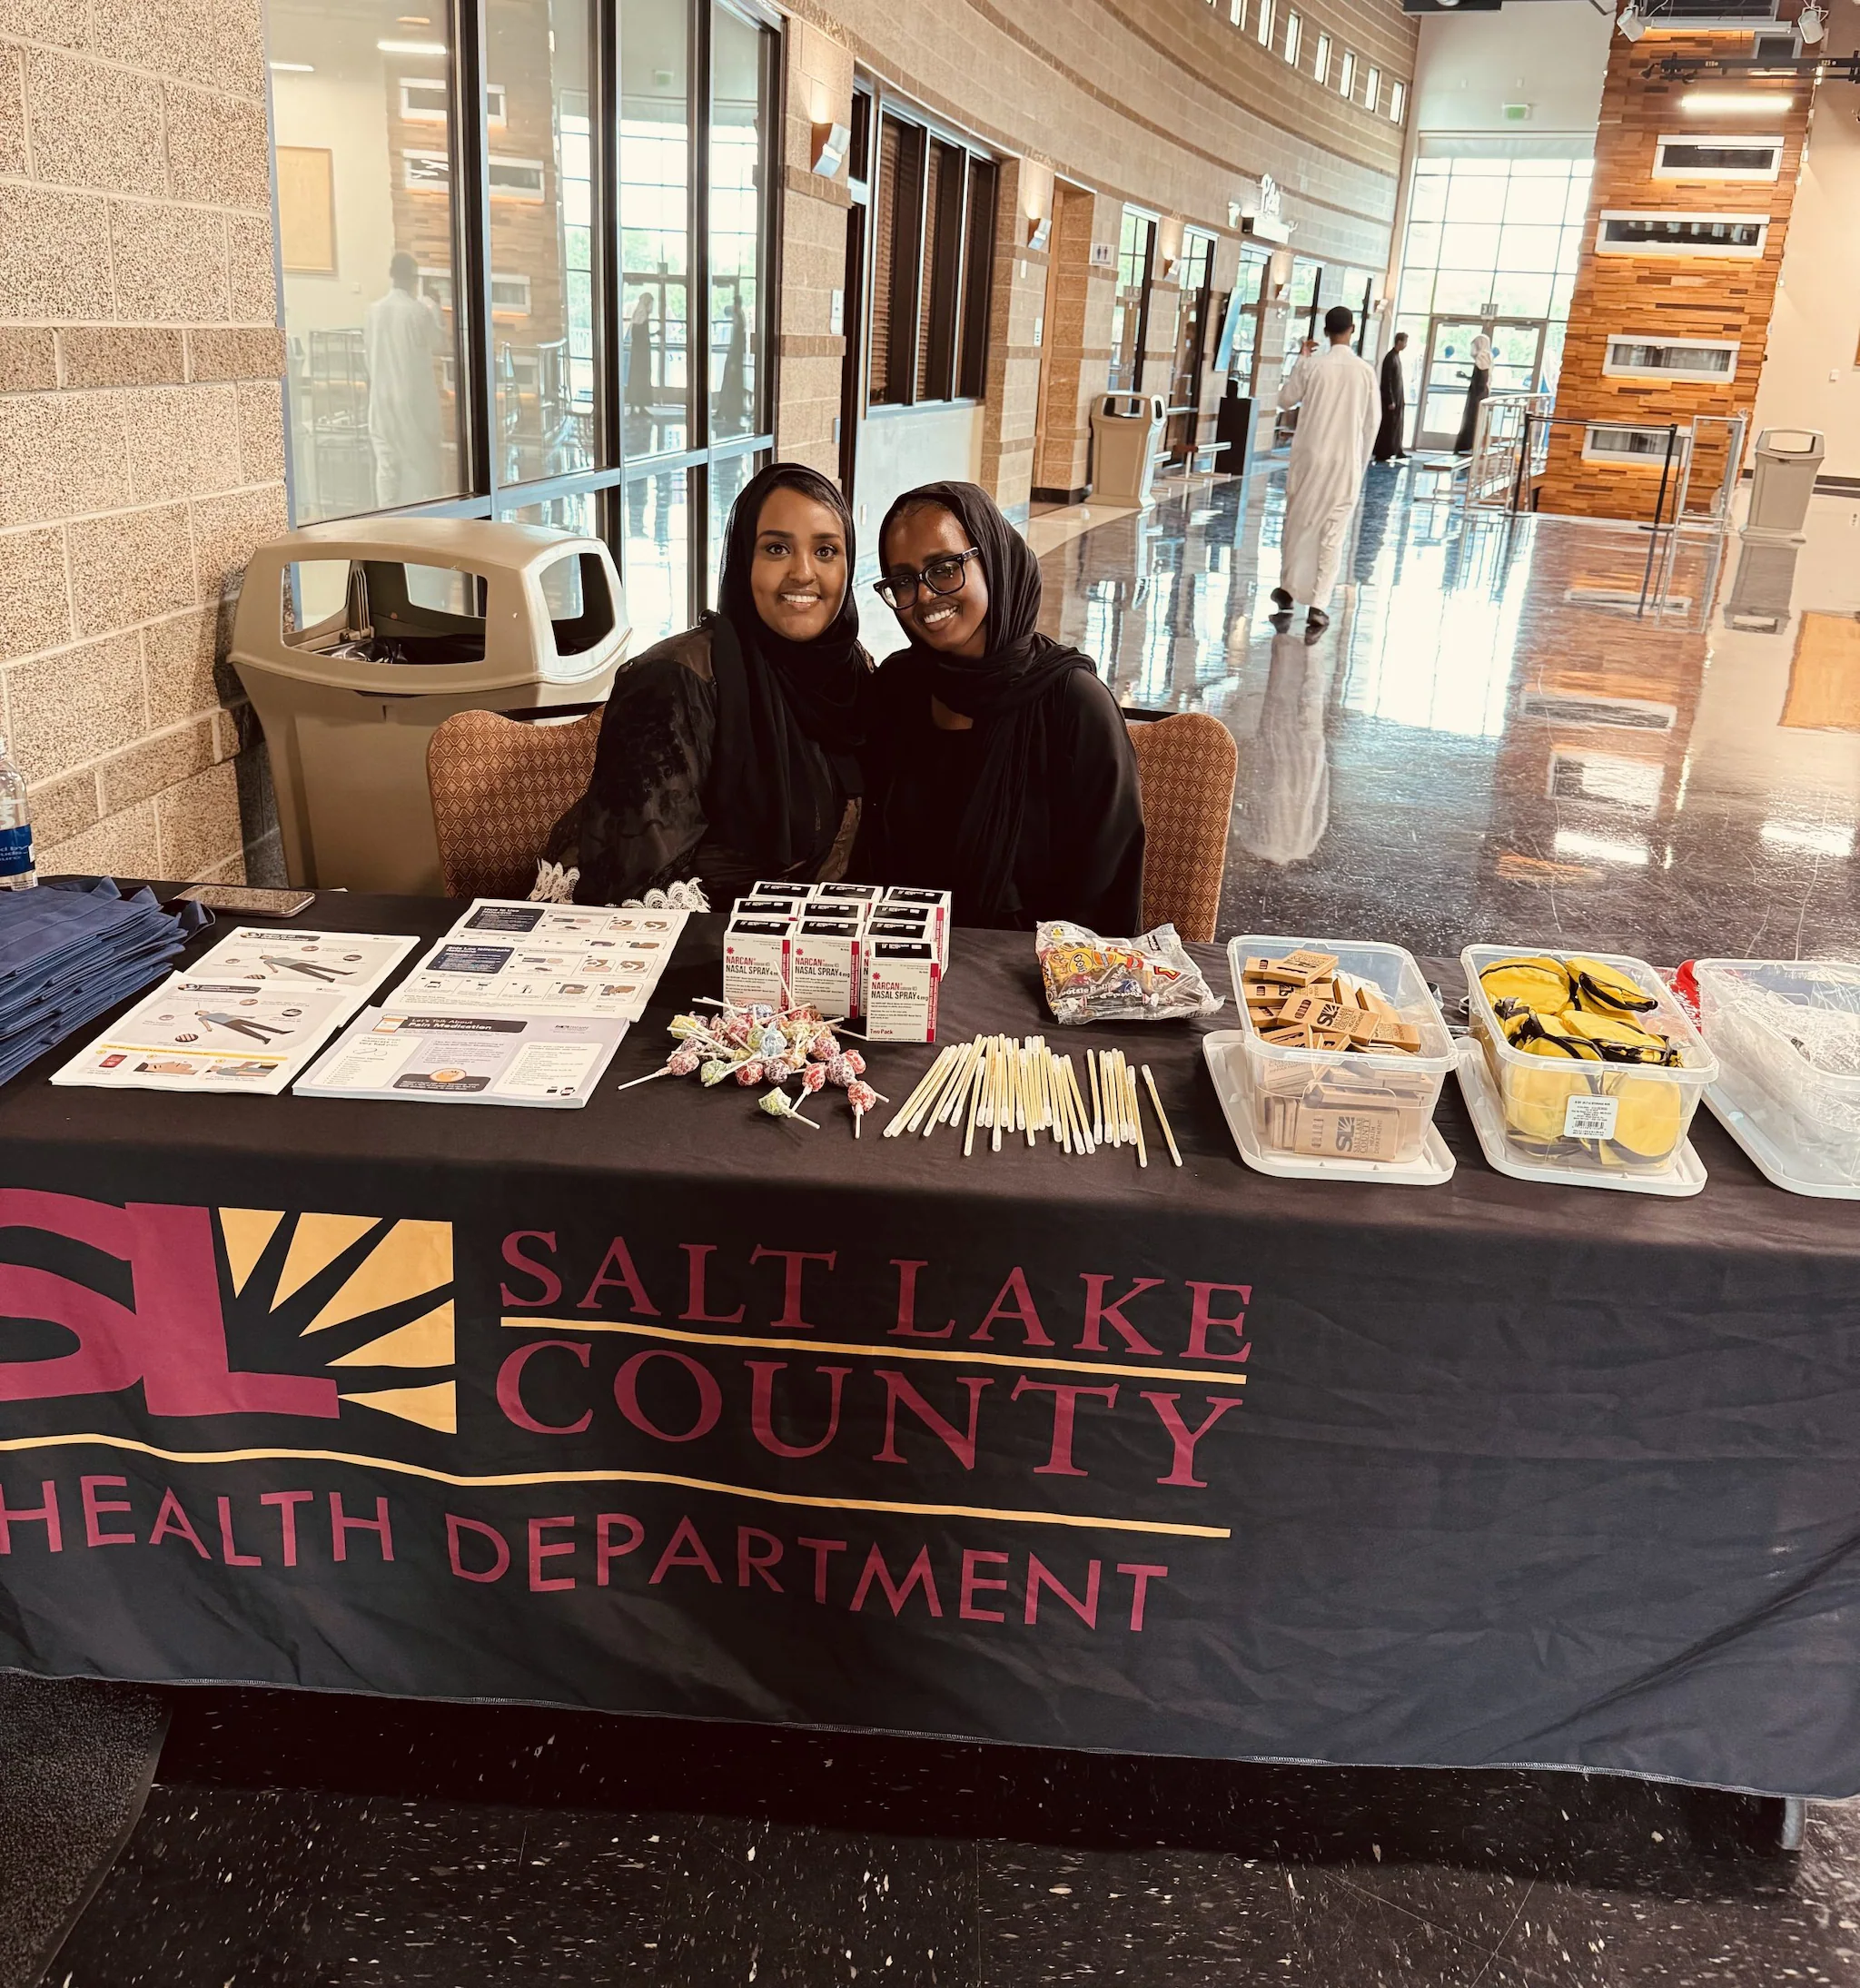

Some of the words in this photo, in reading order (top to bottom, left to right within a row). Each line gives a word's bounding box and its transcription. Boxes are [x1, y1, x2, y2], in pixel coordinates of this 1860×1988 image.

[726, 955, 753, 966] NARCAN
[795, 957, 823, 967] NARCAN
[726, 965, 747, 974] NASAL
[748, 966, 770, 975] SPRAY
[795, 966, 816, 975] NASAL
[817, 967, 839, 976] SPRAY
[871, 982, 900, 991] NARCAN
[871, 991, 893, 999] NASAL
[895, 992, 917, 1000] SPRAY
[434, 1023, 492, 1031] Medication
[1338, 1008, 1354, 1031] COUNTY
[1355, 1117, 1363, 1134] LAKE
[1360, 1119, 1370, 1153] COUNTY
[0, 1189, 341, 1418] SL
[500, 1231, 837, 1329] SALT
[888, 1259, 1254, 1362] LAKE
[496, 1340, 1243, 1489] COUNTY
[0, 1475, 395, 1567] HEALTH
[445, 1512, 1168, 1632] DEPARTMENT
